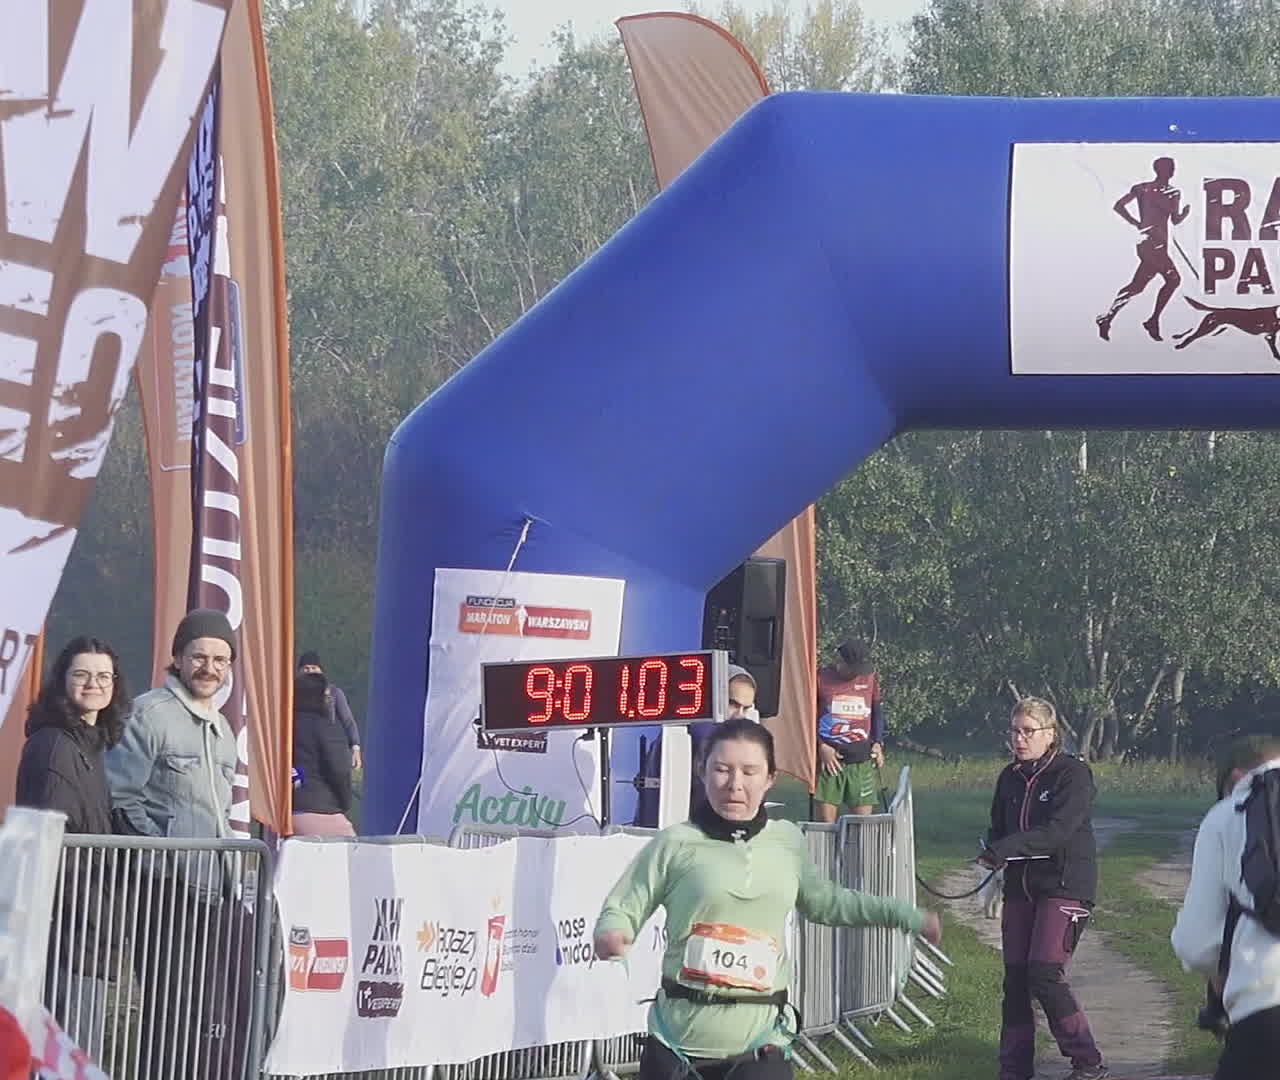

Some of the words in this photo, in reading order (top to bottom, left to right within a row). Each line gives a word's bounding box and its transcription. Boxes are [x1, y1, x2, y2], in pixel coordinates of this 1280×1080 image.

[466, 612, 512, 625] MARATON
[527, 616, 588, 631] WARSZAWSKI
[712, 949, 749, 971] 104
